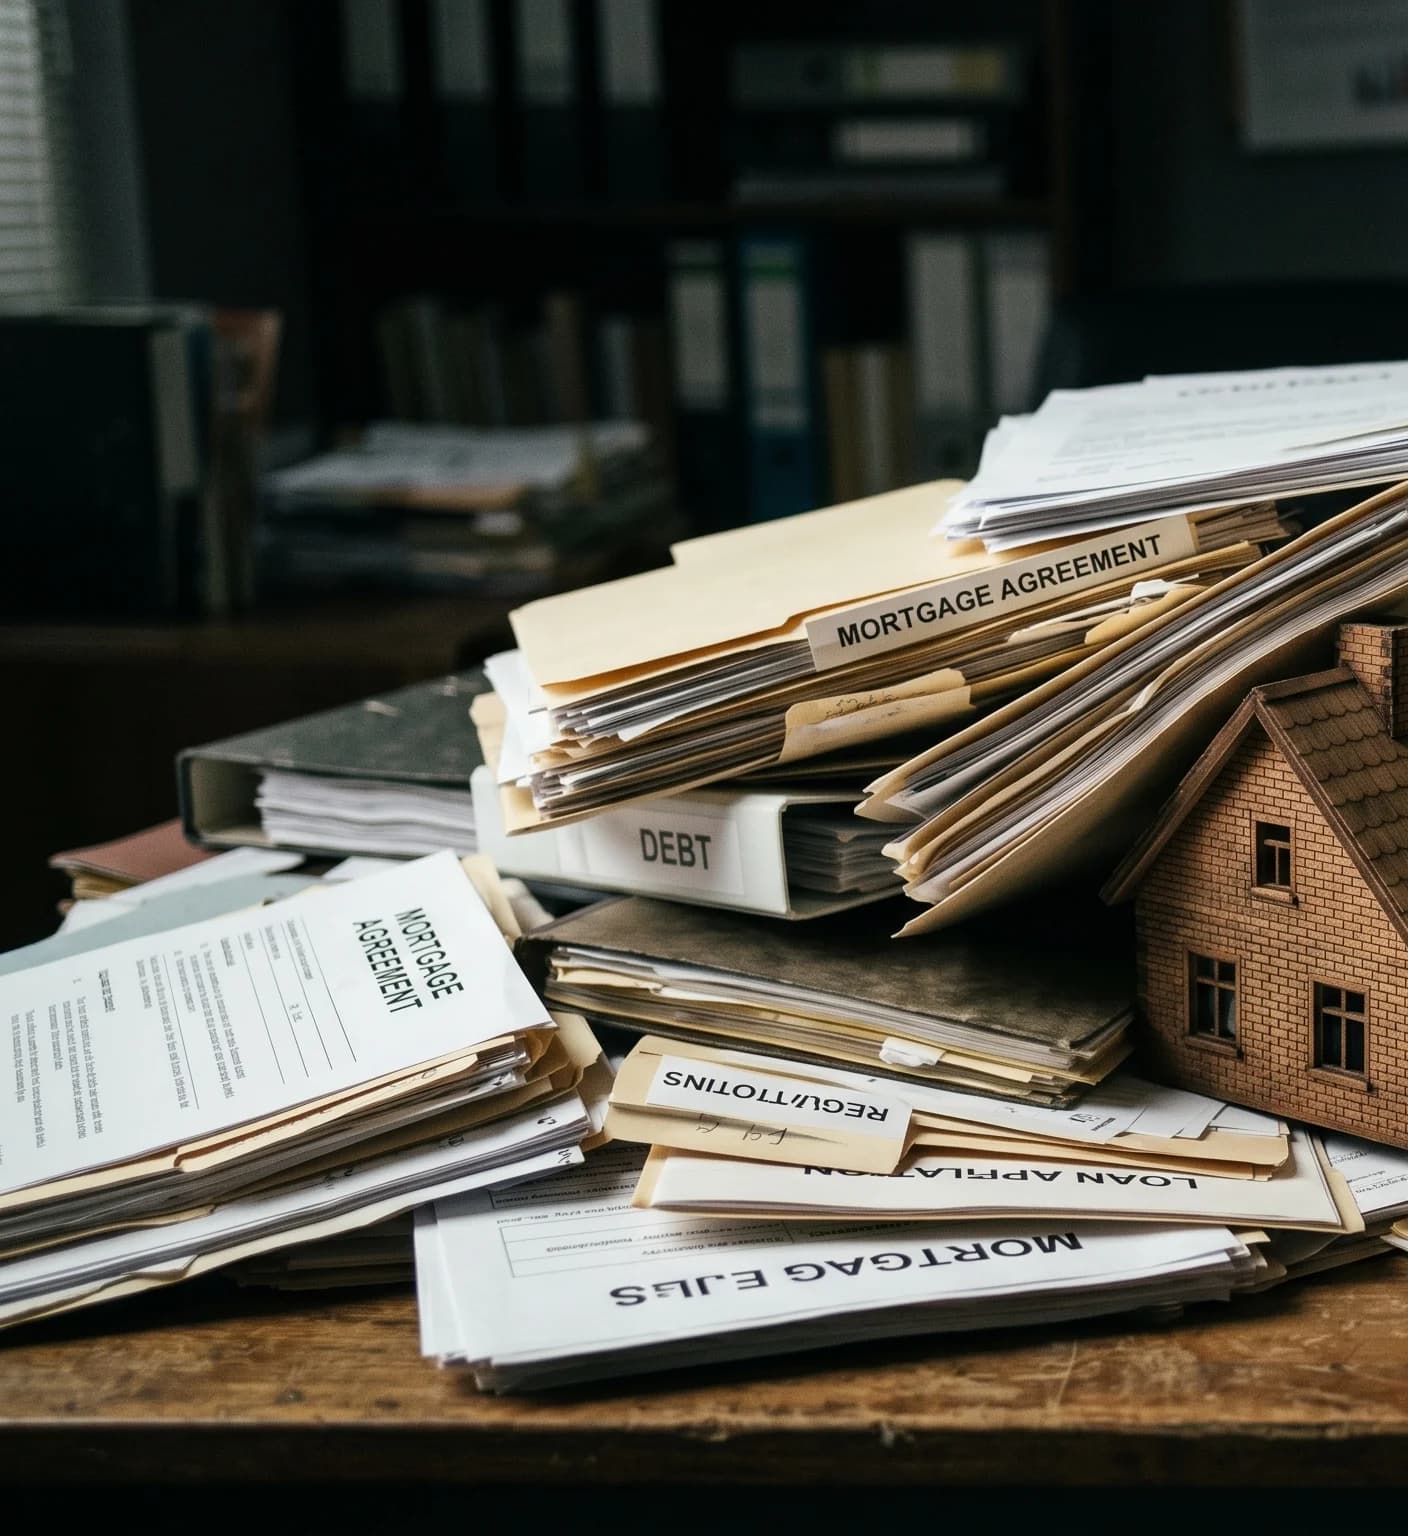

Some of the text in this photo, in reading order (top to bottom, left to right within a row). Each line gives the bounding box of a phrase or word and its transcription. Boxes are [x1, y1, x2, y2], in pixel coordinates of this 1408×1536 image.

[836, 534, 1164, 648] MORTGAGE AGREEMENT
[638, 827, 713, 870] DEBT
[351, 918, 423, 1014] AGREEMENT
[394, 906, 465, 1000] MORTGAGE
[1075, 1172, 1200, 1190] LOAN
[783, 1230, 1084, 1283] MORTGAG
